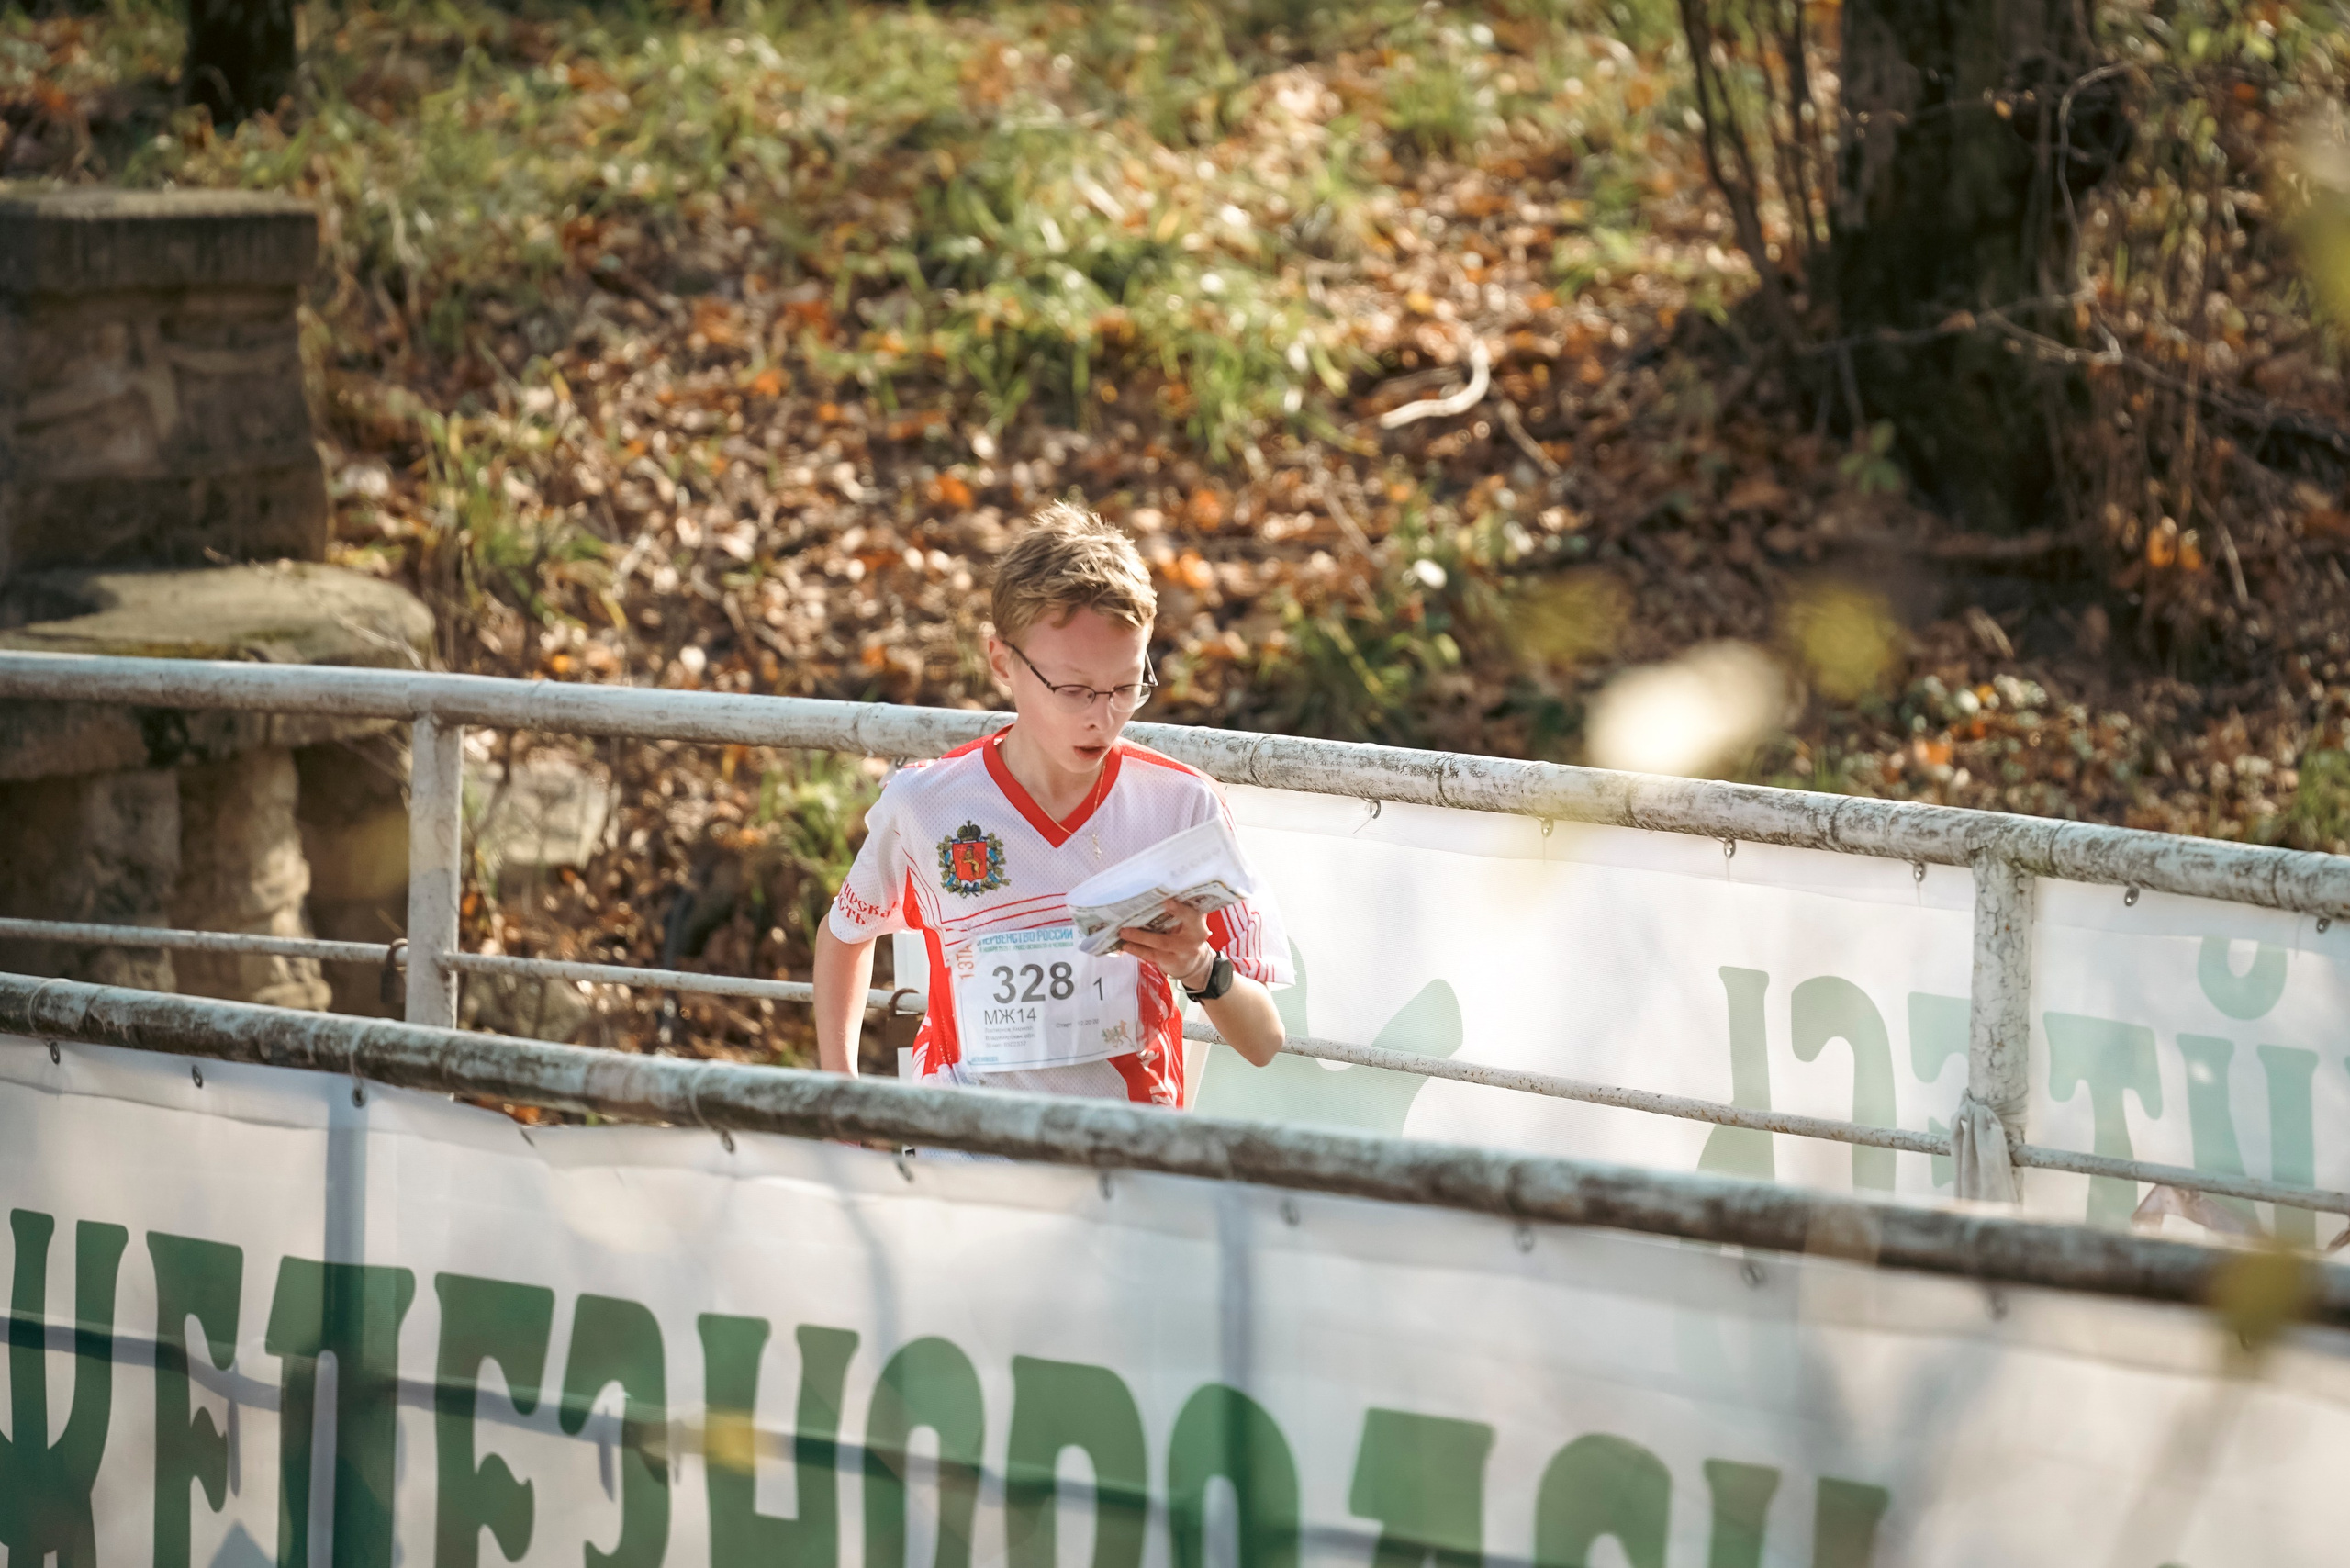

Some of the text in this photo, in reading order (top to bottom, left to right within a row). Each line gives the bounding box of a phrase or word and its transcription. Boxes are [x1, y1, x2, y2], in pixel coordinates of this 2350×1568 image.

[1036, 927, 1073, 942] РОССИИ
[992, 961, 1103, 1004] 328 1
[984, 1007, 1037, 1025] МЖ14
